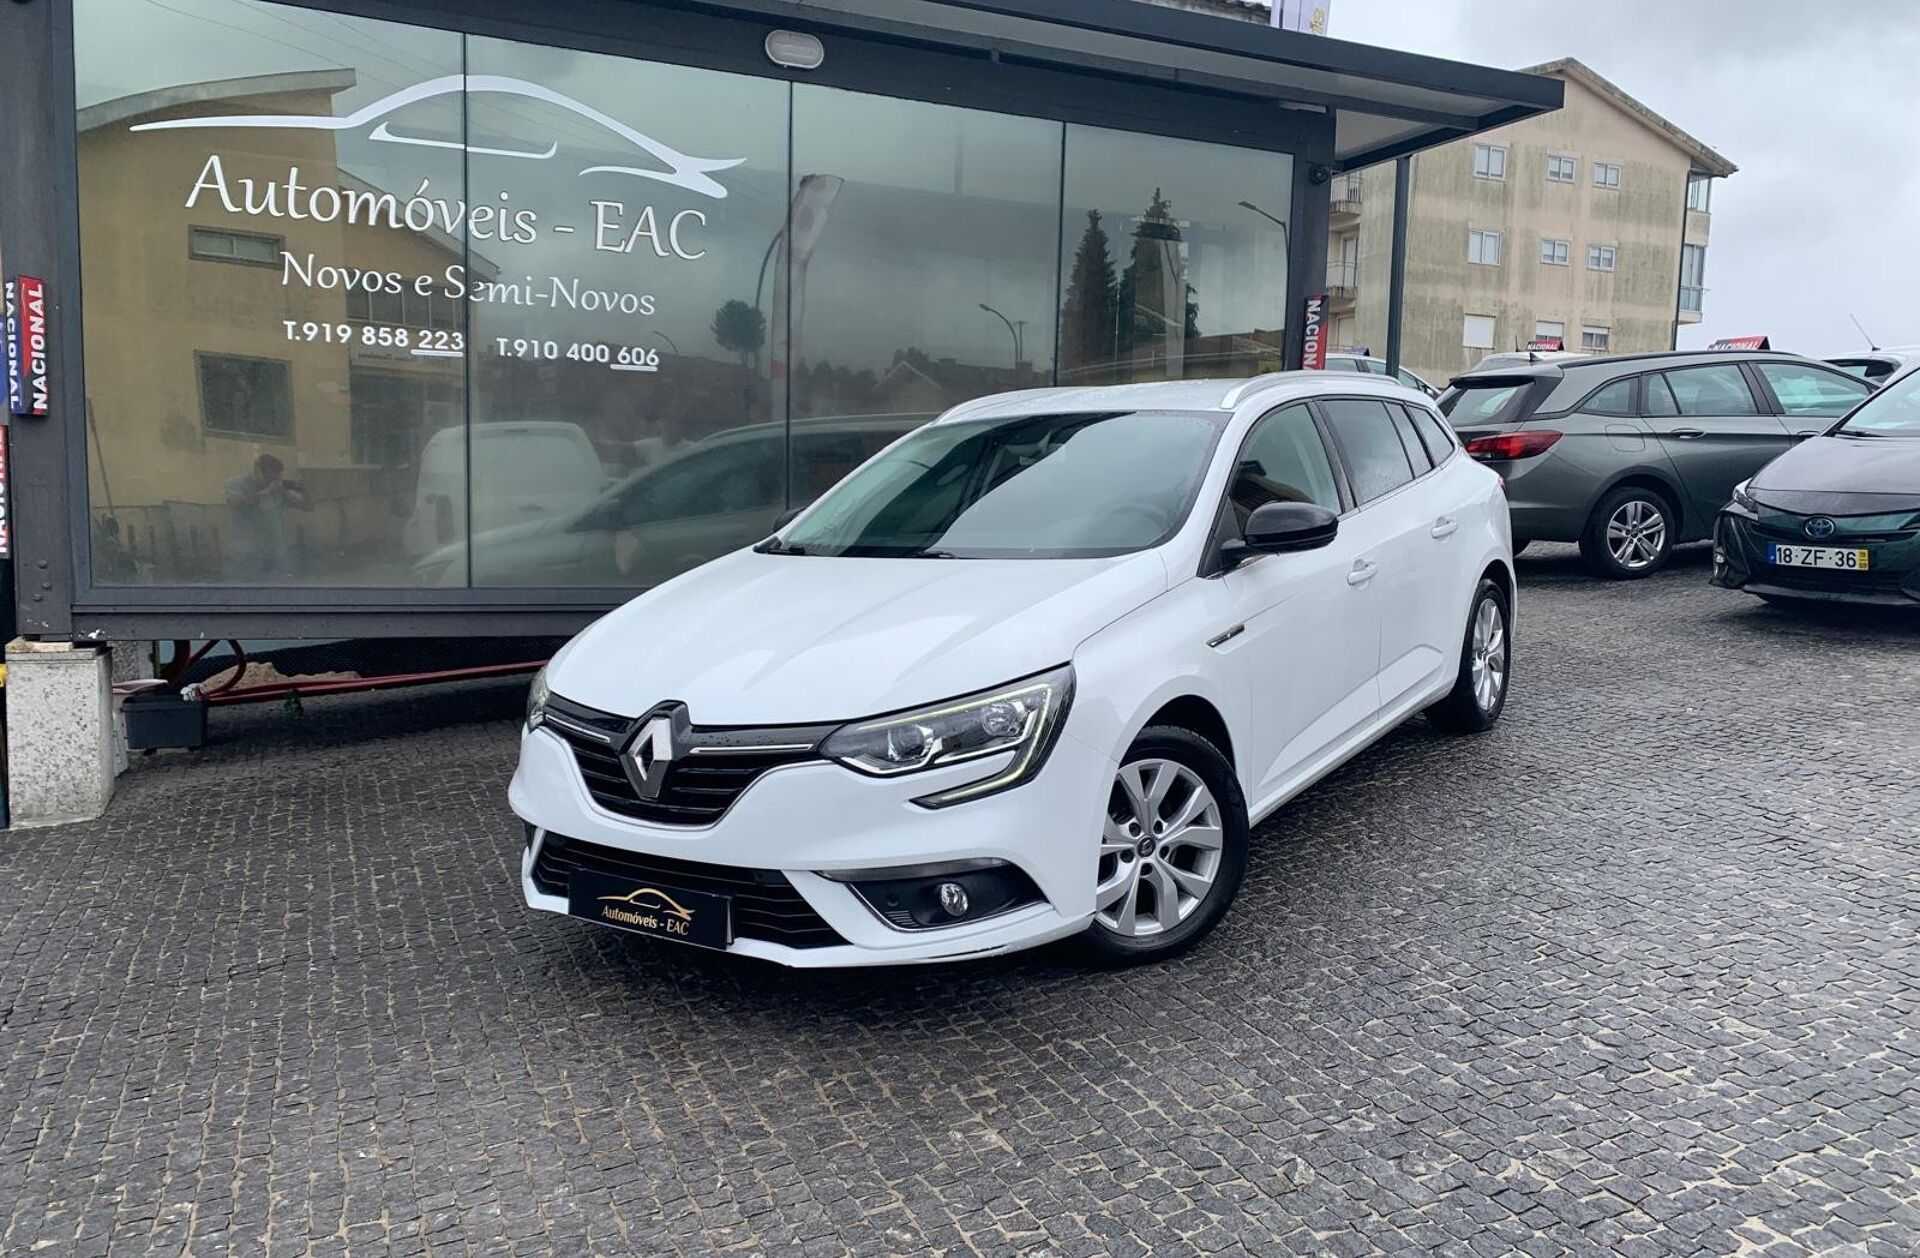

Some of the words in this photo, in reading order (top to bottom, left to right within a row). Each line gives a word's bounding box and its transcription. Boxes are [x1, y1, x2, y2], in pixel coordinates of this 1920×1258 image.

[185, 155, 537, 244] Automóveis
[590, 201, 707, 260] EAC
[280, 251, 402, 294] Novos
[414, 274, 433, 296] e
[444, 264, 656, 316] Semi-Novos
[6, 282, 19, 409] NACIONAL
[28, 284, 48, 410] NACIONAL
[283, 320, 352, 343] T.919
[361, 326, 409, 347] 858
[418, 330, 464, 350] 223
[496, 337, 558, 359] T.910
[566, 343, 609, 363] 400
[617, 347, 660, 366] 606
[602, 905, 657, 929] Automóveis
[667, 918, 690, 936] EAC
